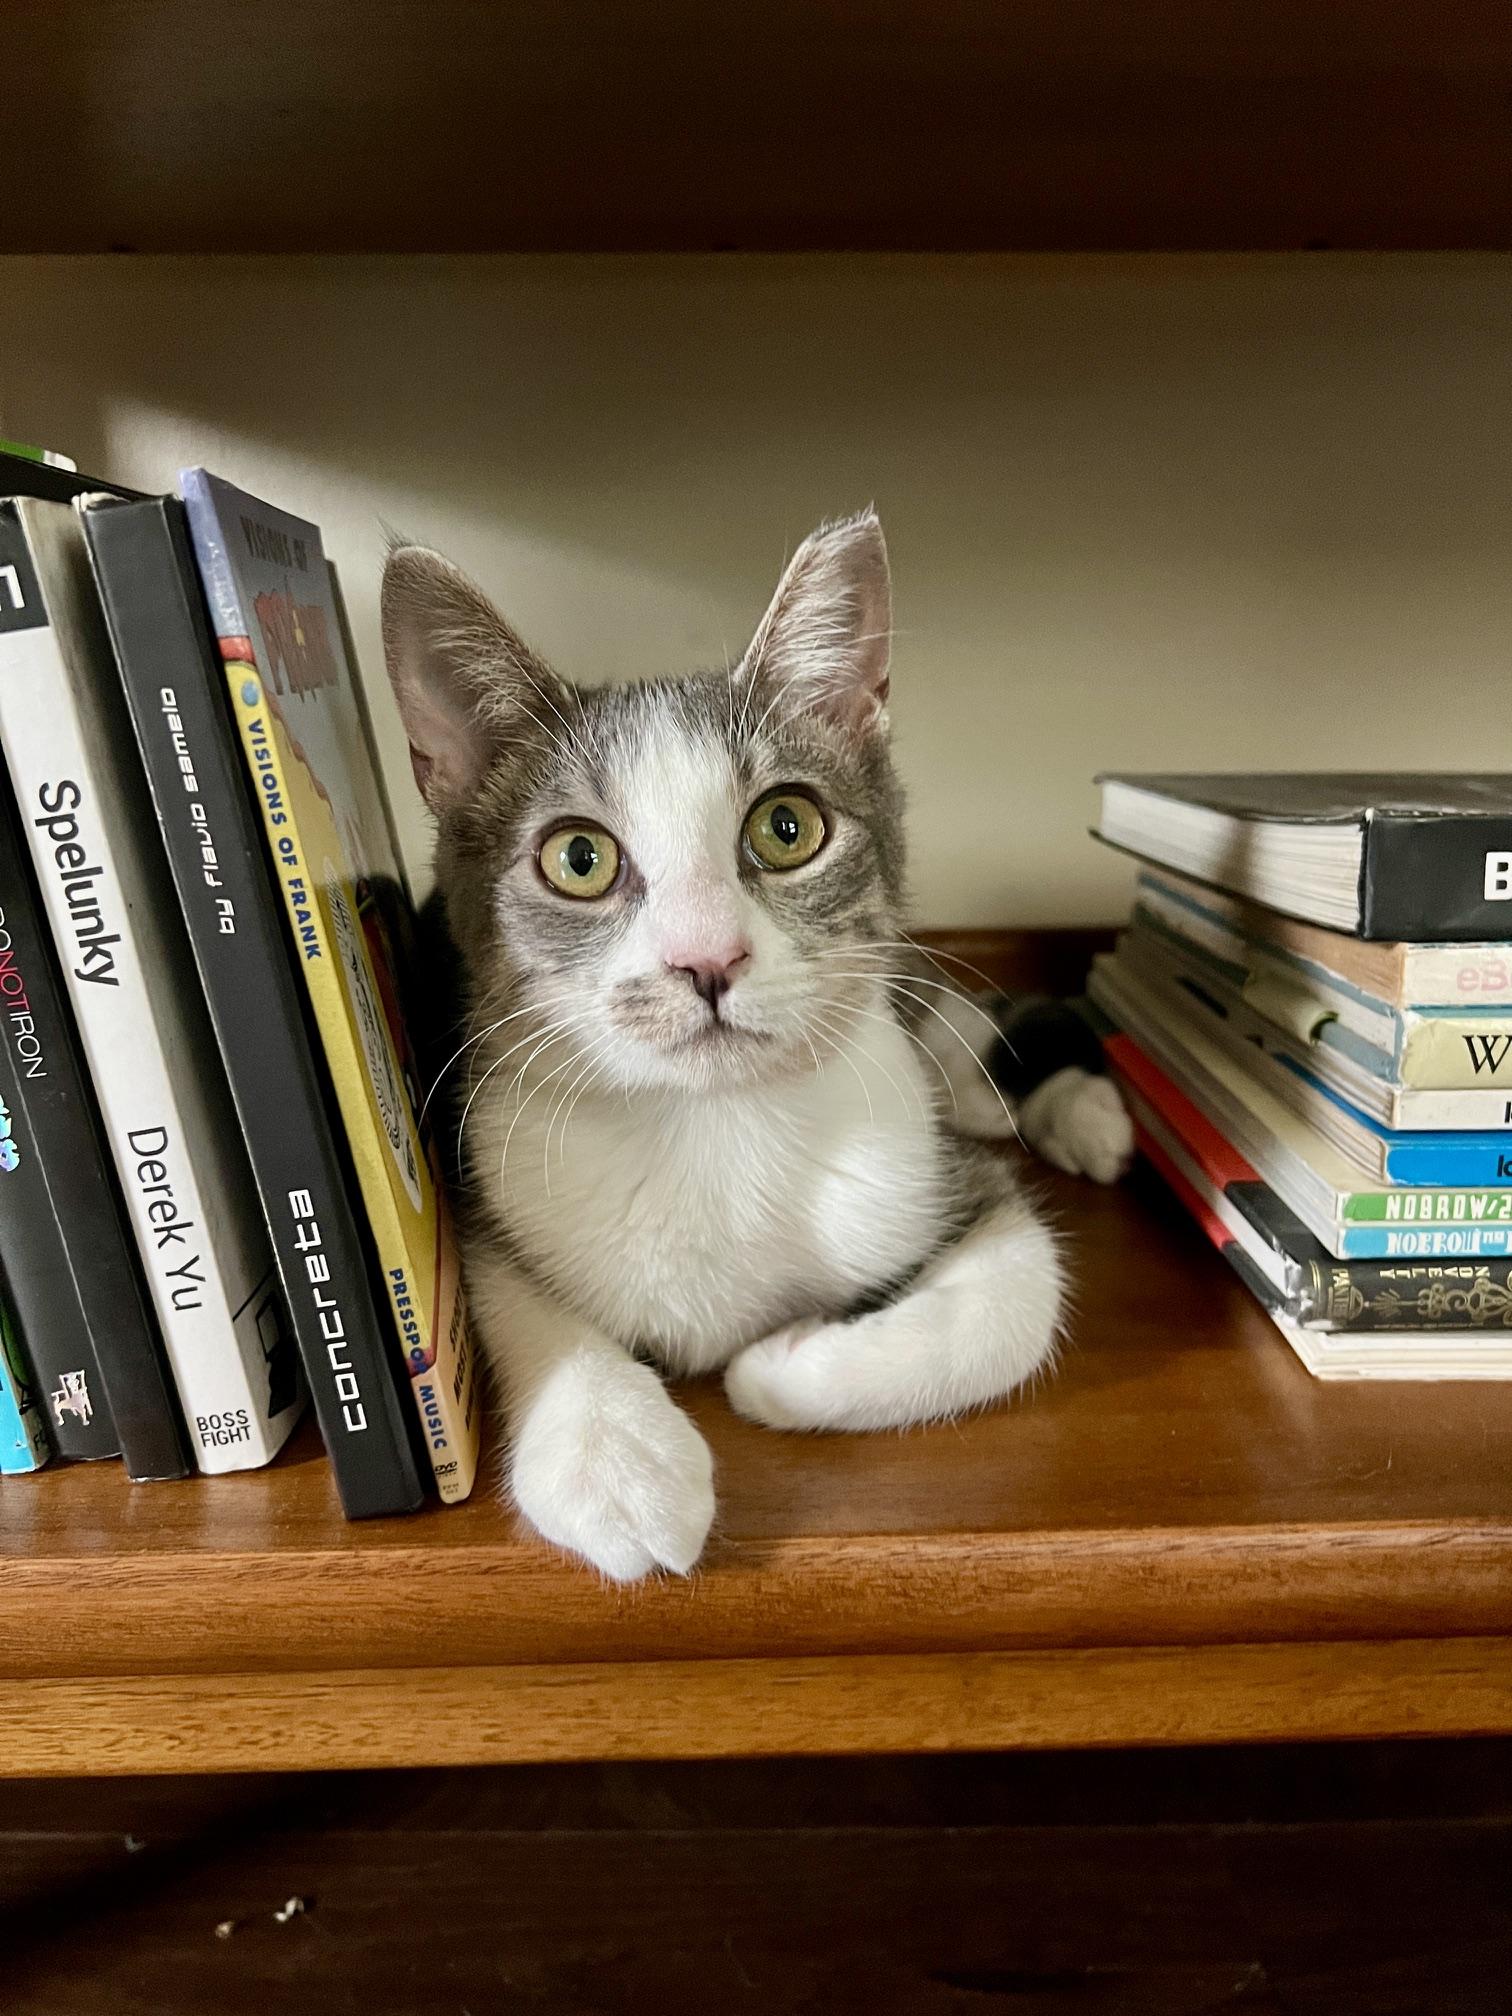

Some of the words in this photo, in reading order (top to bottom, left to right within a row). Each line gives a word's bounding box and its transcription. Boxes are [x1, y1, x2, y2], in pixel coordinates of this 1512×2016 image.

[160, 687, 199, 792] samelo
[247, 717, 287, 827] VISIONS
[34, 779, 121, 987] Spelunky
[190, 803, 223, 887] flavio
[278, 835, 298, 867] OF
[215, 898, 235, 934] by
[287, 877, 322, 961] FRANK
[127, 1126, 194, 1249] Derek
[165, 1254, 206, 1311] Yu
[288, 1189, 368, 1432] concreta
[388, 1267, 427, 1374] PRESSPOP
[419, 1385, 447, 1450] MUSIC
[196, 1409, 249, 1432] BOSS
[200, 1424, 252, 1448] FIGHT
